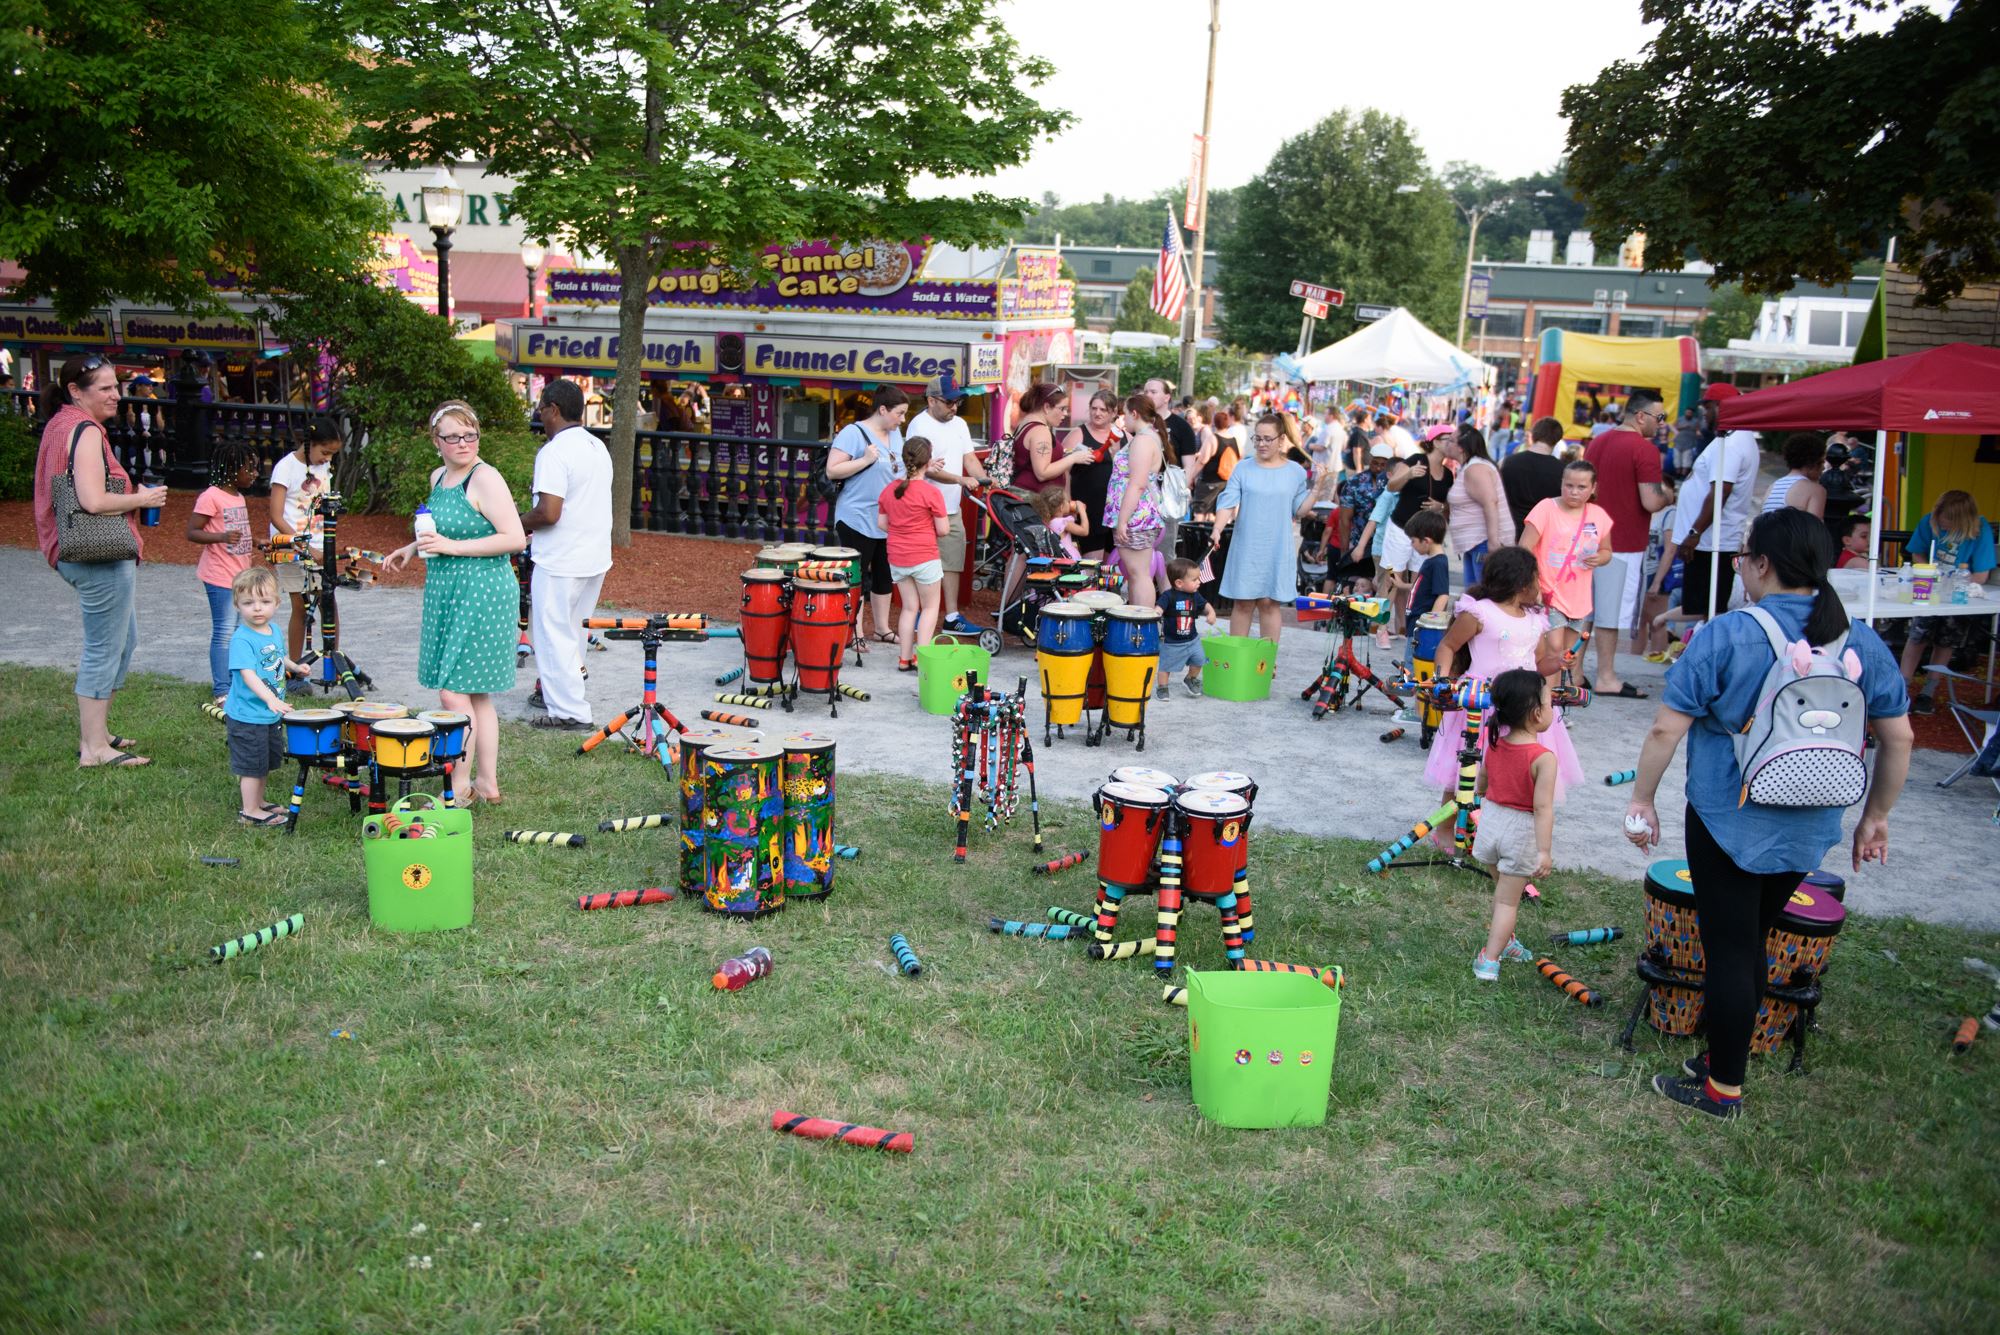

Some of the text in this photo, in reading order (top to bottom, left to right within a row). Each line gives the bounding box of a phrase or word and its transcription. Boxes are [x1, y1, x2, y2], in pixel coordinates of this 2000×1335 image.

[364, 191, 514, 226] ATRY
[760, 247, 875, 274] Funnel
[554, 281, 622, 293] Soda & Water
[778, 275, 859, 297] Cake
[1305, 286, 1327, 300] MAIN
[912, 291, 940, 302] Soda
[942, 292, 952, 302] &
[955, 292, 991, 304] Water
[127, 320, 185, 343] Sausage
[528, 333, 702, 368] Fried Dugh
[755, 344, 956, 377] Funnel Cakes
[978, 347, 998, 358] Fried
[972, 369, 1001, 379] Cookies
